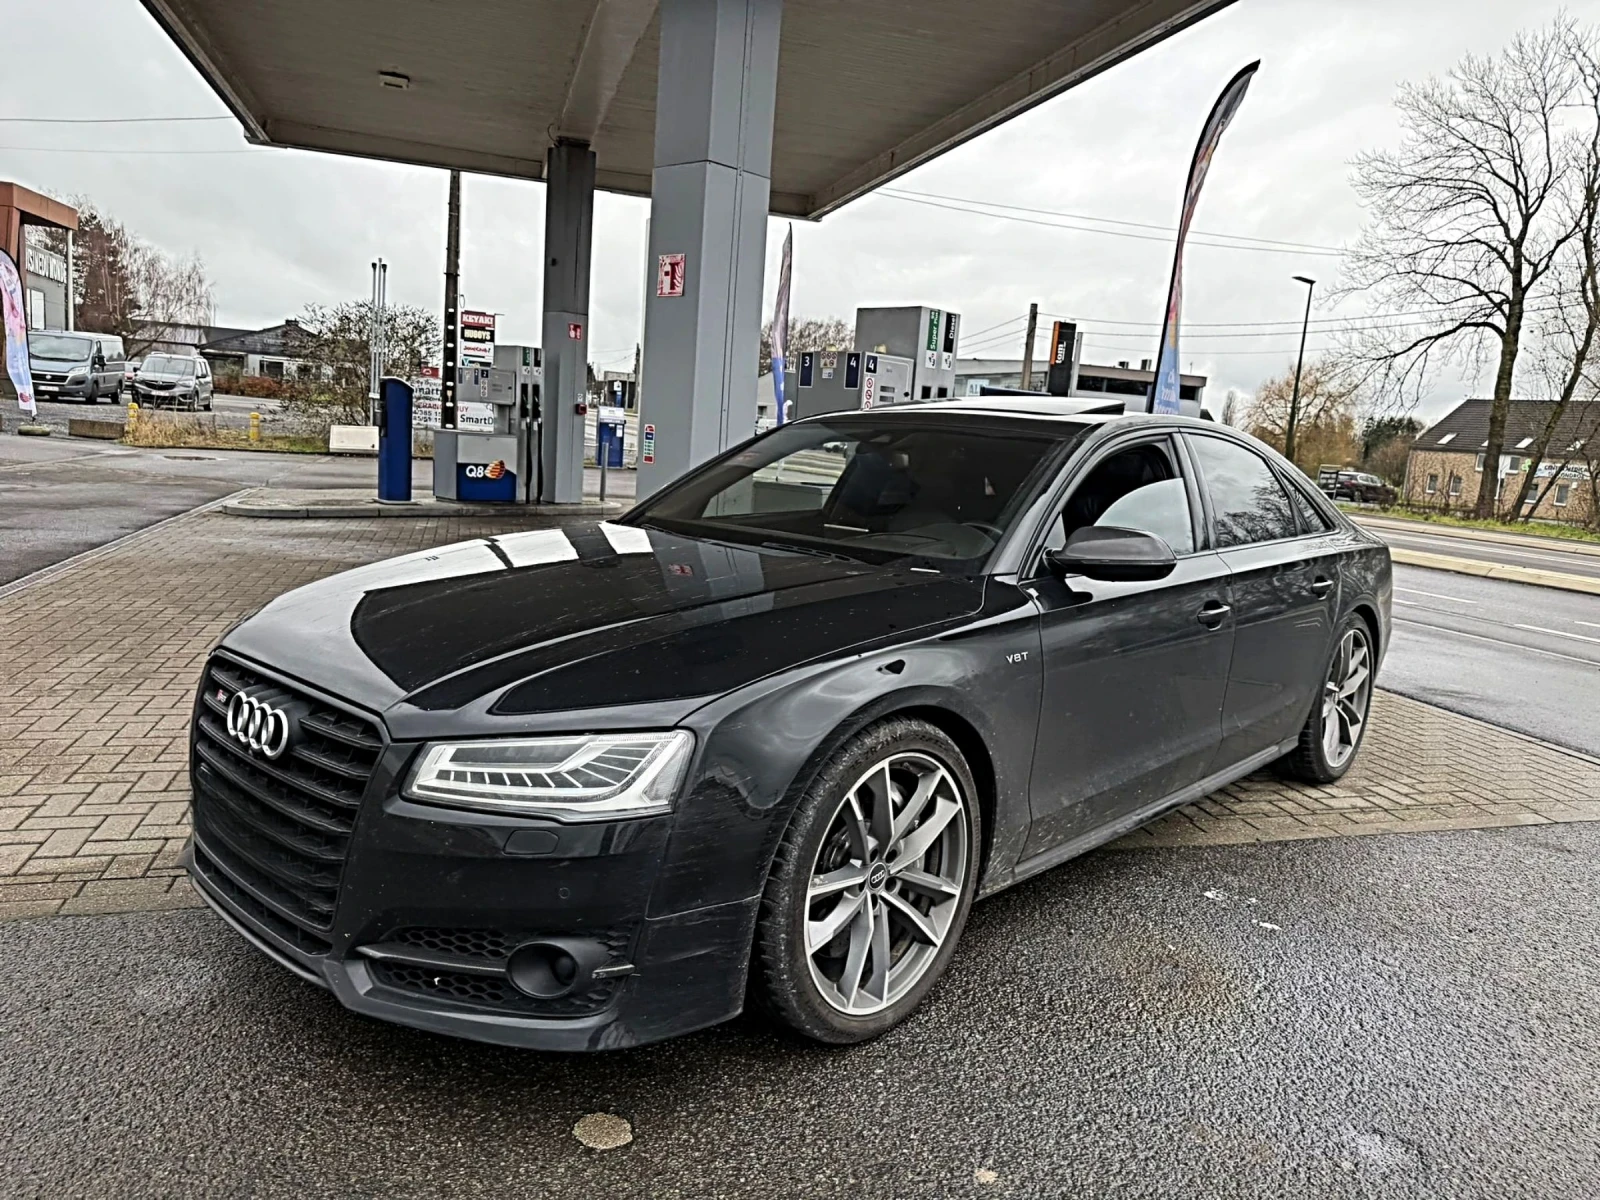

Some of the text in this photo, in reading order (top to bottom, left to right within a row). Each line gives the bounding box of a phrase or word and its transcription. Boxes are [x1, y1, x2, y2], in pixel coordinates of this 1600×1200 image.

[948, 314, 956, 339] Diesel
[930, 325, 938, 350] Super
[804, 356, 810, 367] 3
[850, 357, 856, 368] 4
[868, 360, 874, 371] 4
[466, 465, 484, 478] Q8
[1006, 651, 1028, 664] V8T
